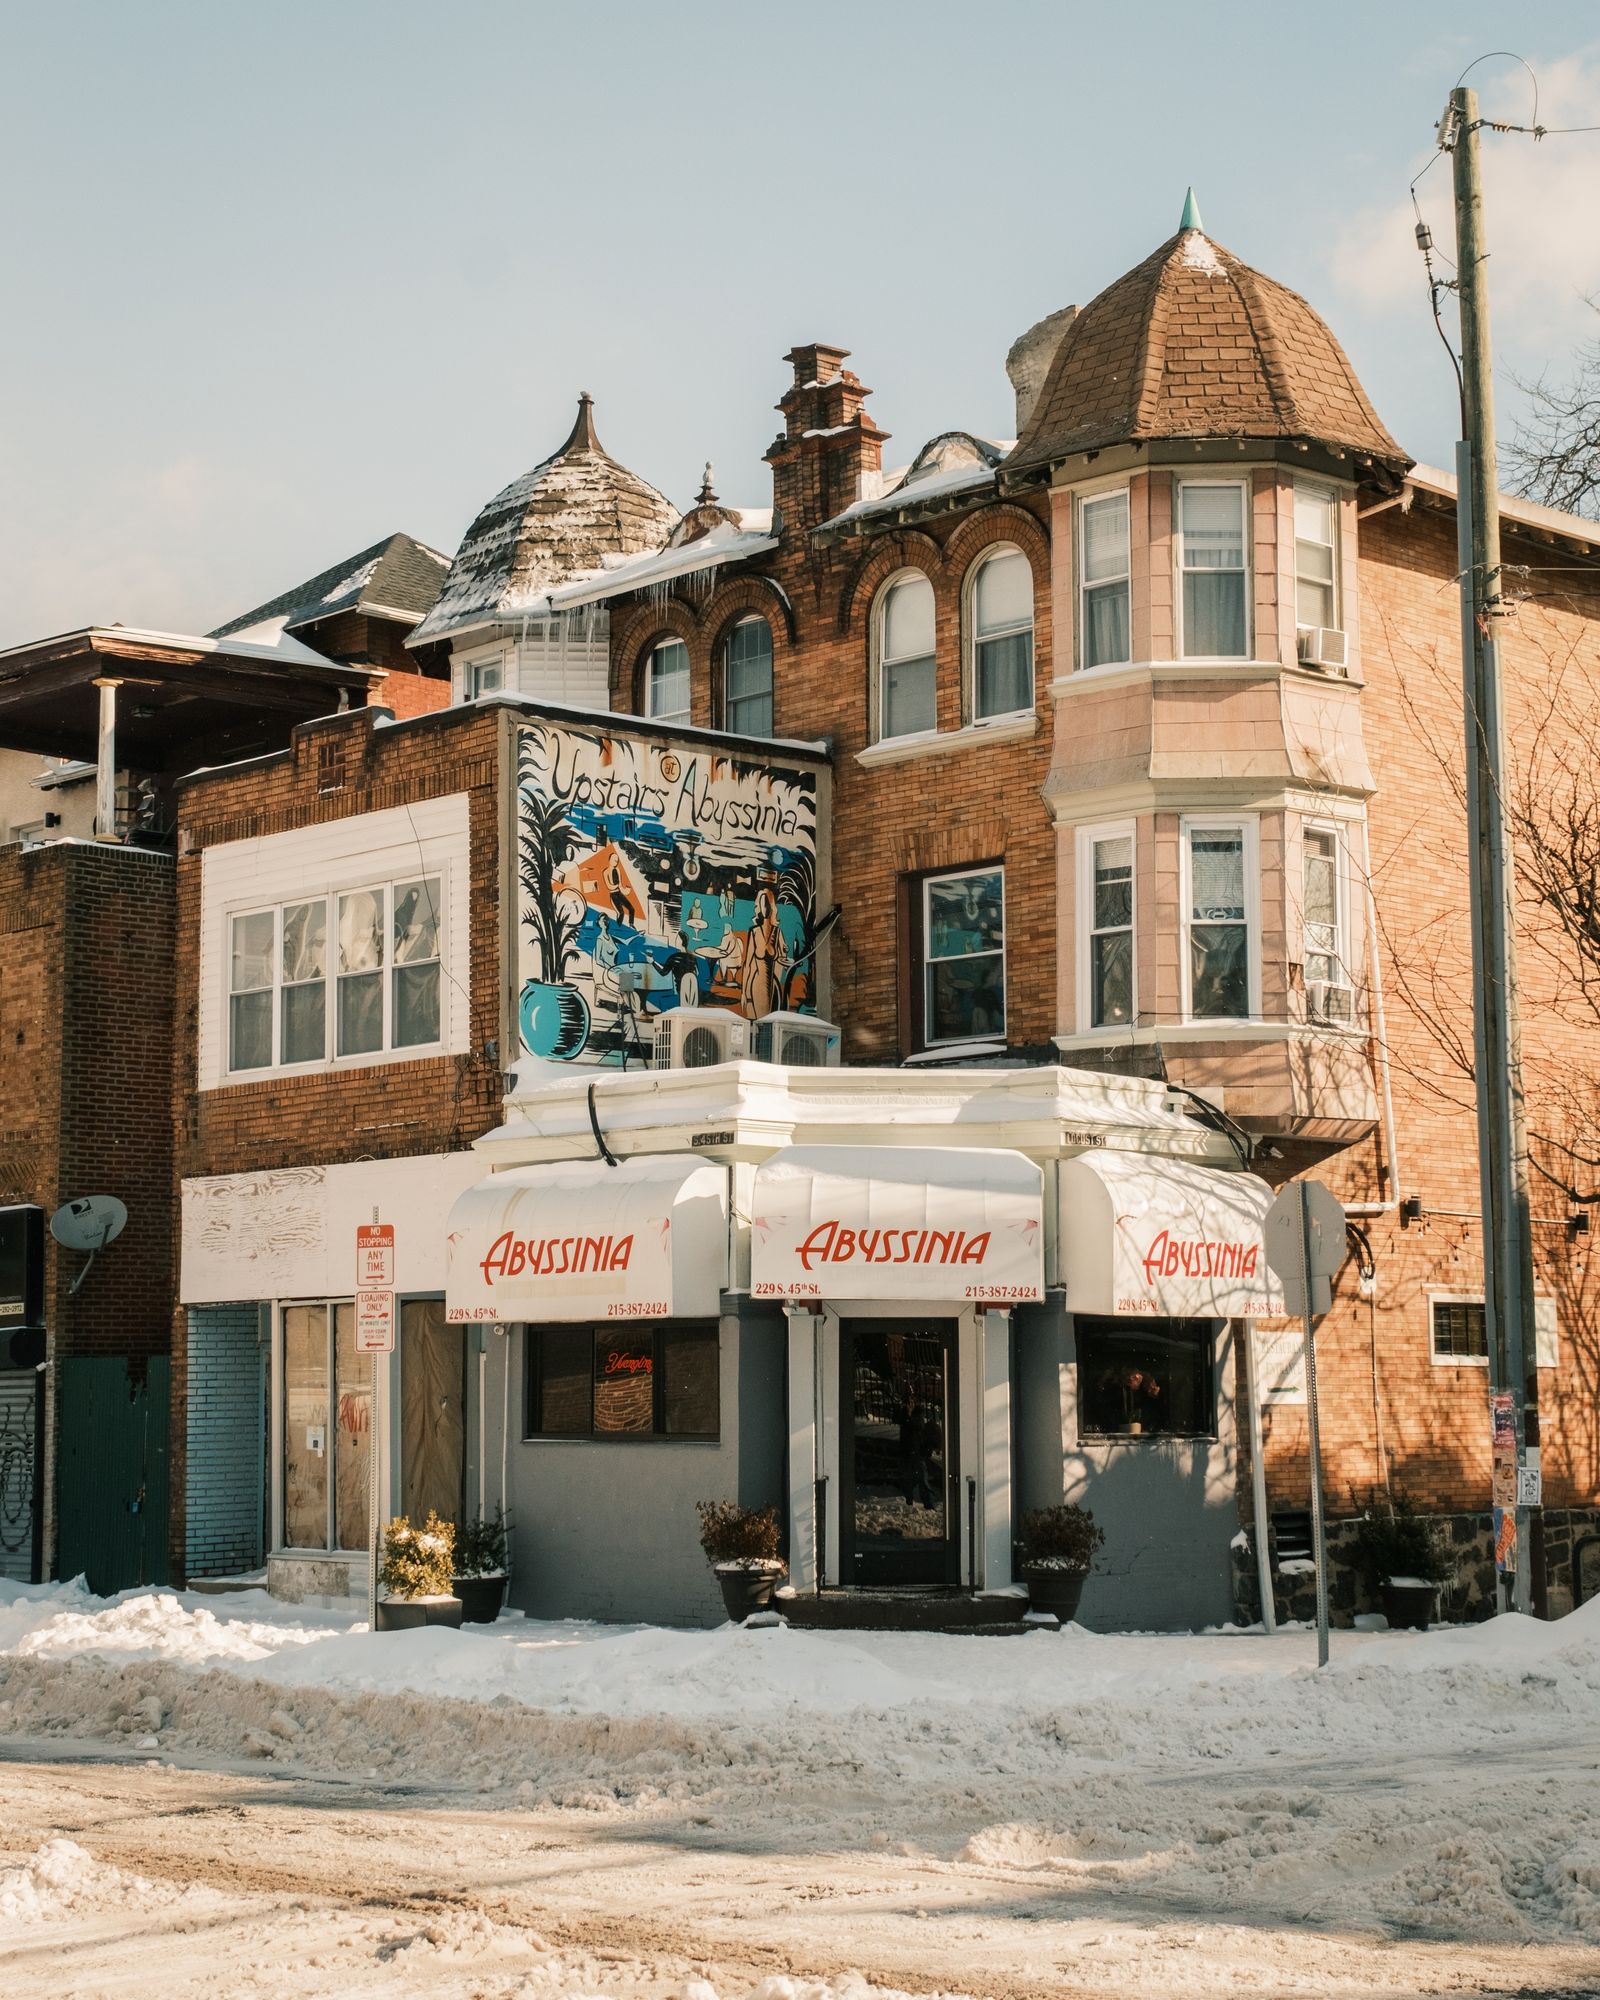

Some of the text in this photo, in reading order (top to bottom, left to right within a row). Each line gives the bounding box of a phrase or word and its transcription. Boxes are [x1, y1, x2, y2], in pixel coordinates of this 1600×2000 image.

[551, 732, 669, 817] Upstairs
[674, 757, 799, 841] Abyssinia
[370, 1227, 381, 1236] NO
[358, 1237, 393, 1247] STOPPING
[795, 1220, 991, 1270] ABYSSINIA
[368, 1250, 384, 1260] ANY
[479, 1231, 634, 1285] ABYSSINIA
[1142, 1230, 1259, 1285] ABYSSINIA
[366, 1261, 385, 1271] TIME
[755, 1283, 775, 1295] 229
[777, 1283, 786, 1295] S.
[808, 1283, 821, 1295] St.
[965, 1286, 1037, 1298] 215-387-2424
[361, 1294, 389, 1303] LOADING
[1118, 1298, 1131, 1311] 229
[366, 1303, 383, 1311] ONLY
[607, 1302, 668, 1316] 215-387-2424
[449, 1309, 463, 1320] 229
[463, 1308, 472, 1320] S.
[489, 1307, 499, 1319] St.
